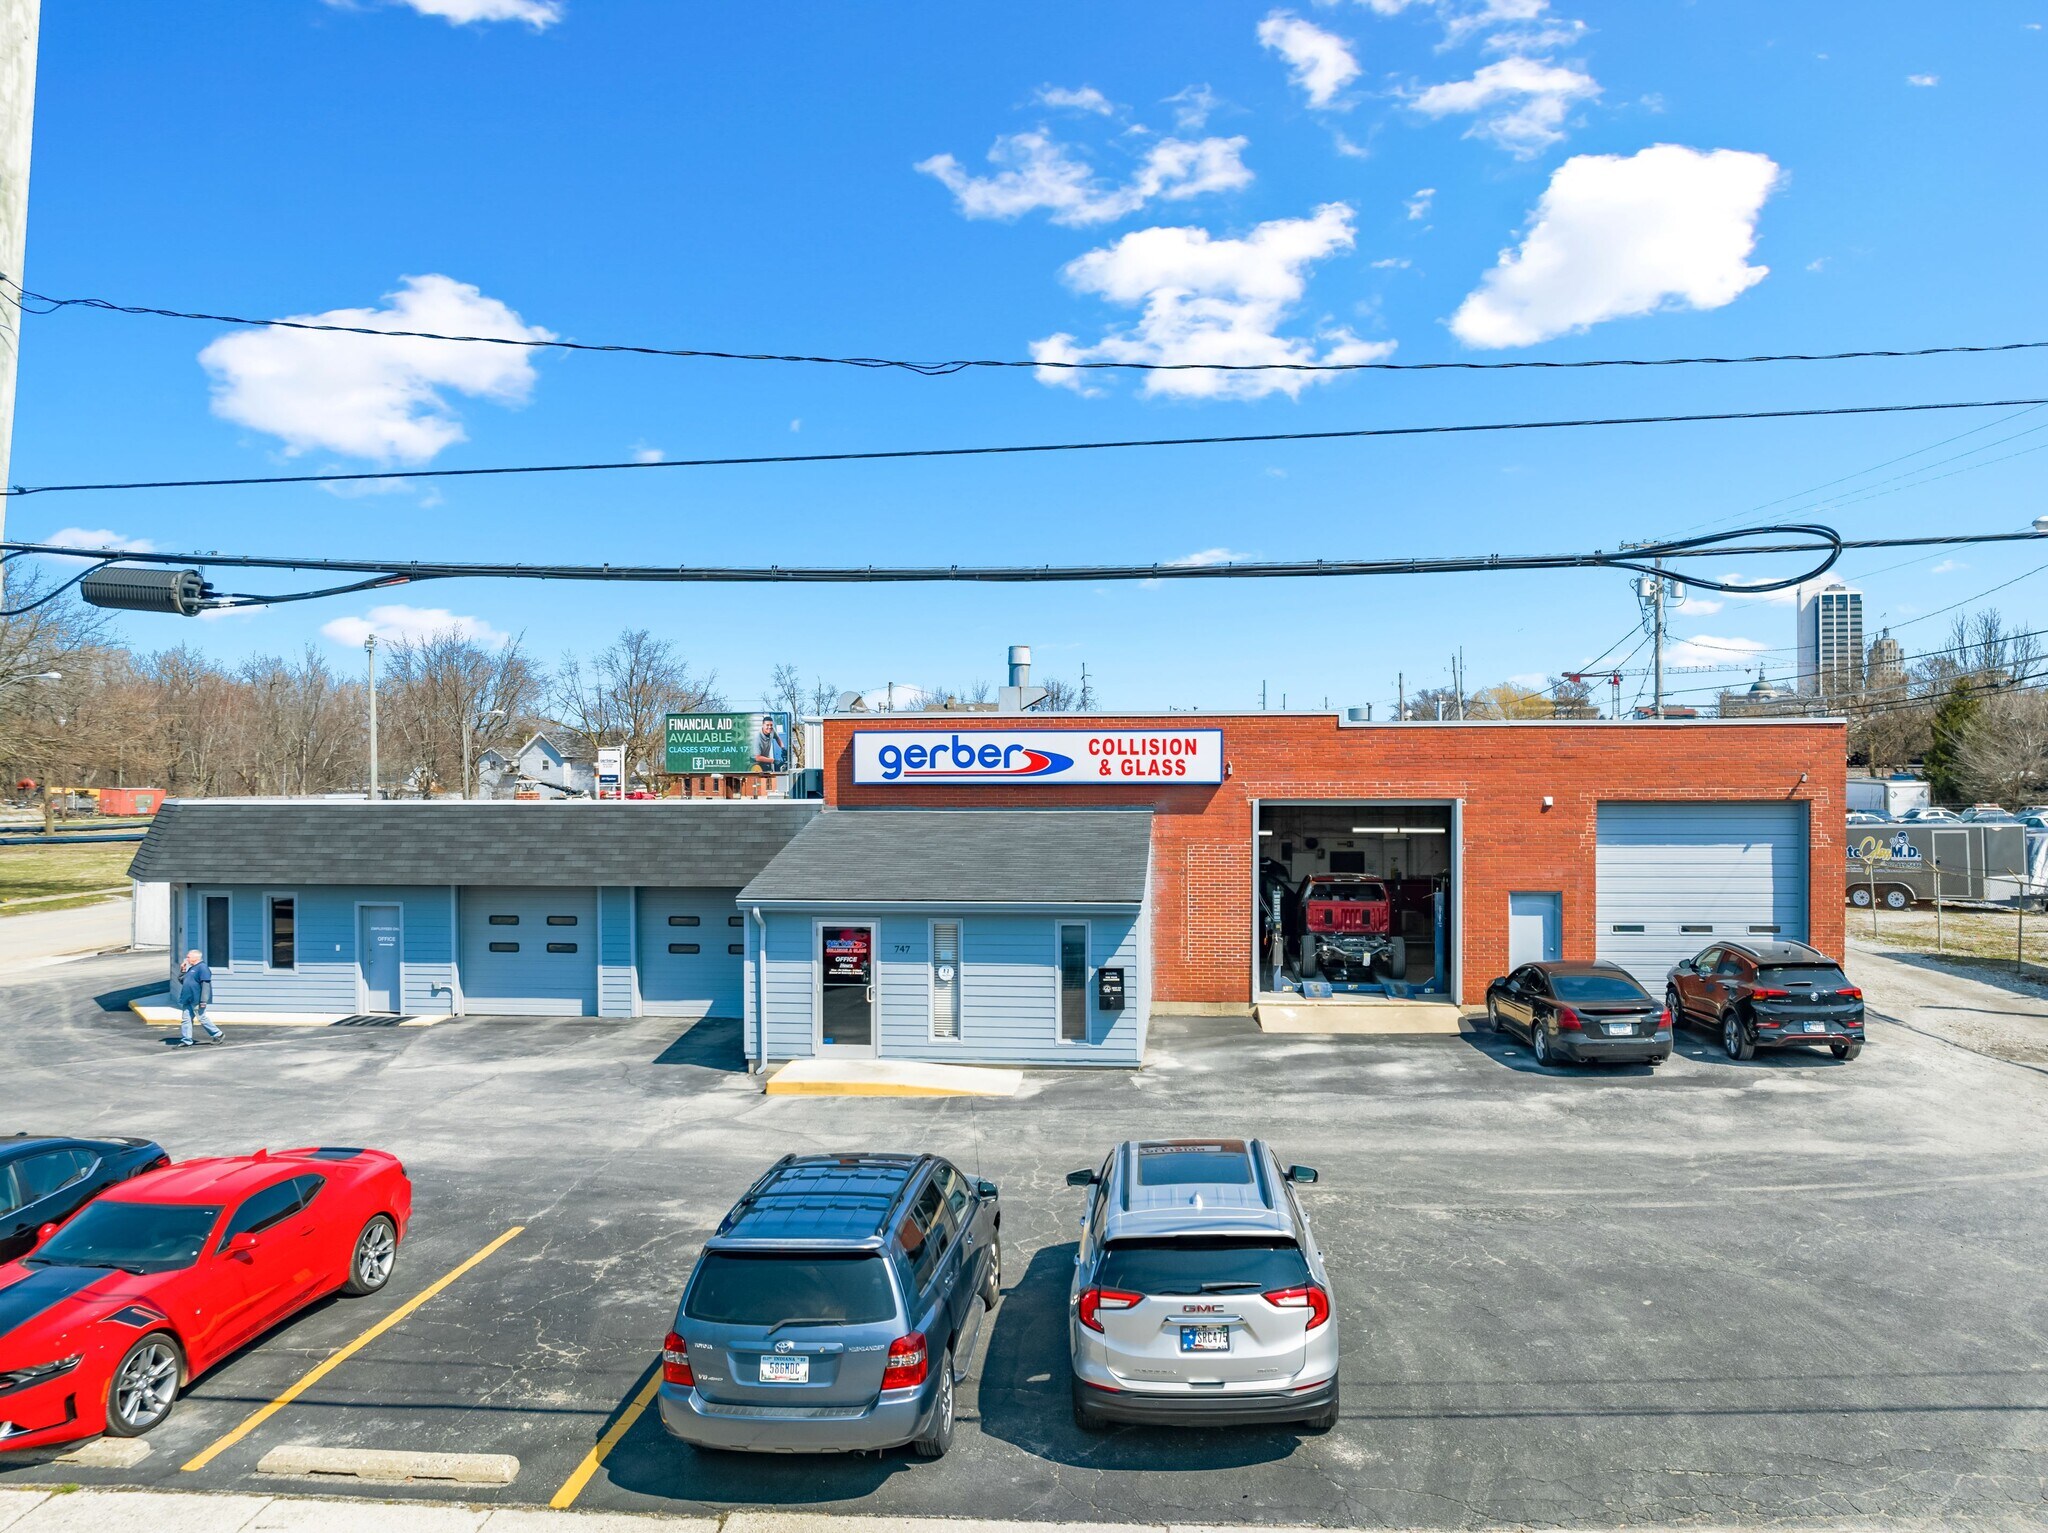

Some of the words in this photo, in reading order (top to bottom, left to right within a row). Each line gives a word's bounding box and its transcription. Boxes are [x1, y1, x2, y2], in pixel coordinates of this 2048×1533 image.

[669, 718, 715, 730] FINANCIAL
[717, 718, 732, 730] AID
[669, 732, 732, 743] AVAILABLE
[1088, 738, 1197, 756] COLLISION
[879, 735, 1024, 780] gerber
[1099, 759, 1112, 776] &
[1121, 759, 1187, 776] GLASS
[1892, 846, 1921, 858] M.D.
[894, 945, 911, 954] 747
[1183, 1304, 1225, 1313] GMC
